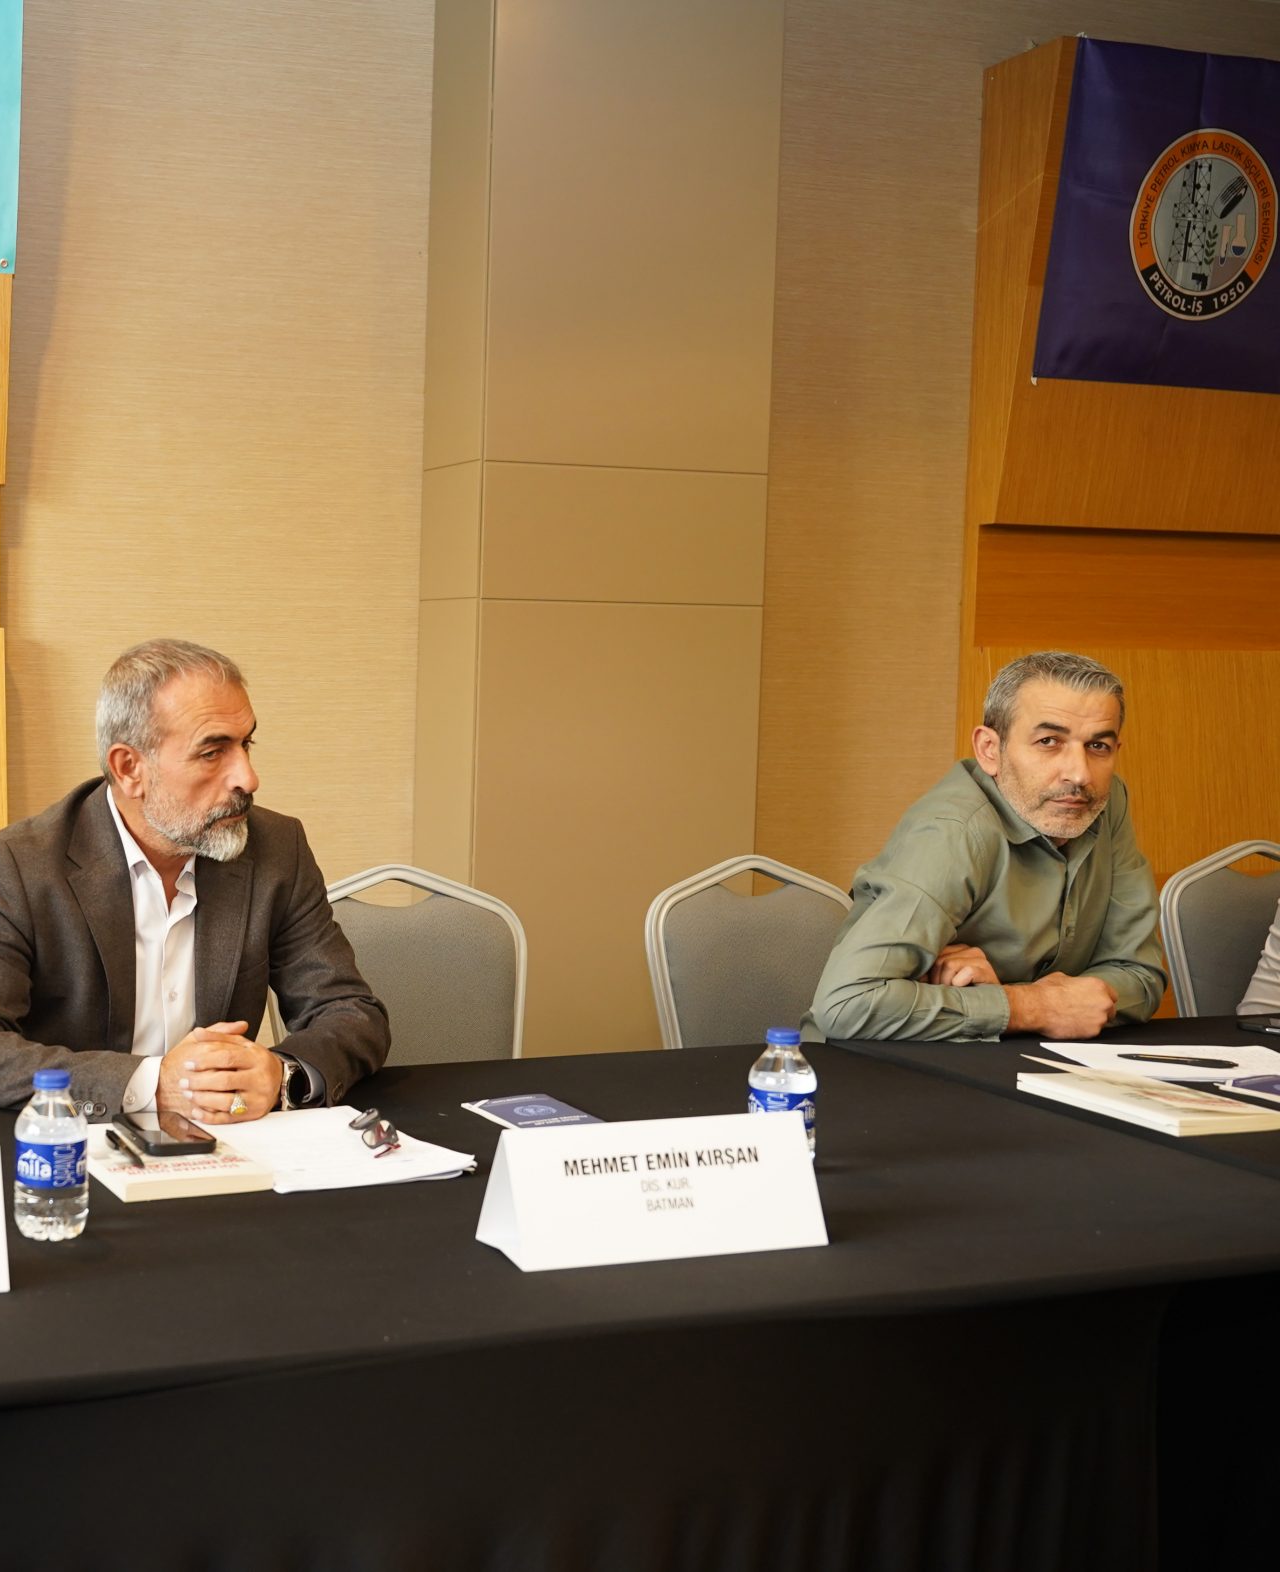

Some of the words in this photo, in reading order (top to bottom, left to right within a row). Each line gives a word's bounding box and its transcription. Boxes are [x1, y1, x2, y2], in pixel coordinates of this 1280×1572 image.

[1137, 194, 1154, 249] TÜRKİYE
[1151, 154, 1180, 193] PETROL
[1149, 271, 1203, 316] PETROL-İŞ
[1213, 281, 1246, 310] 1950
[17, 1157, 52, 1181] mila
[563, 1154, 639, 1177] MEHMET
[645, 1147, 691, 1171] EMİN
[695, 1146, 760, 1171] KIRŞAN
[646, 1196, 696, 1213] BATMAN
